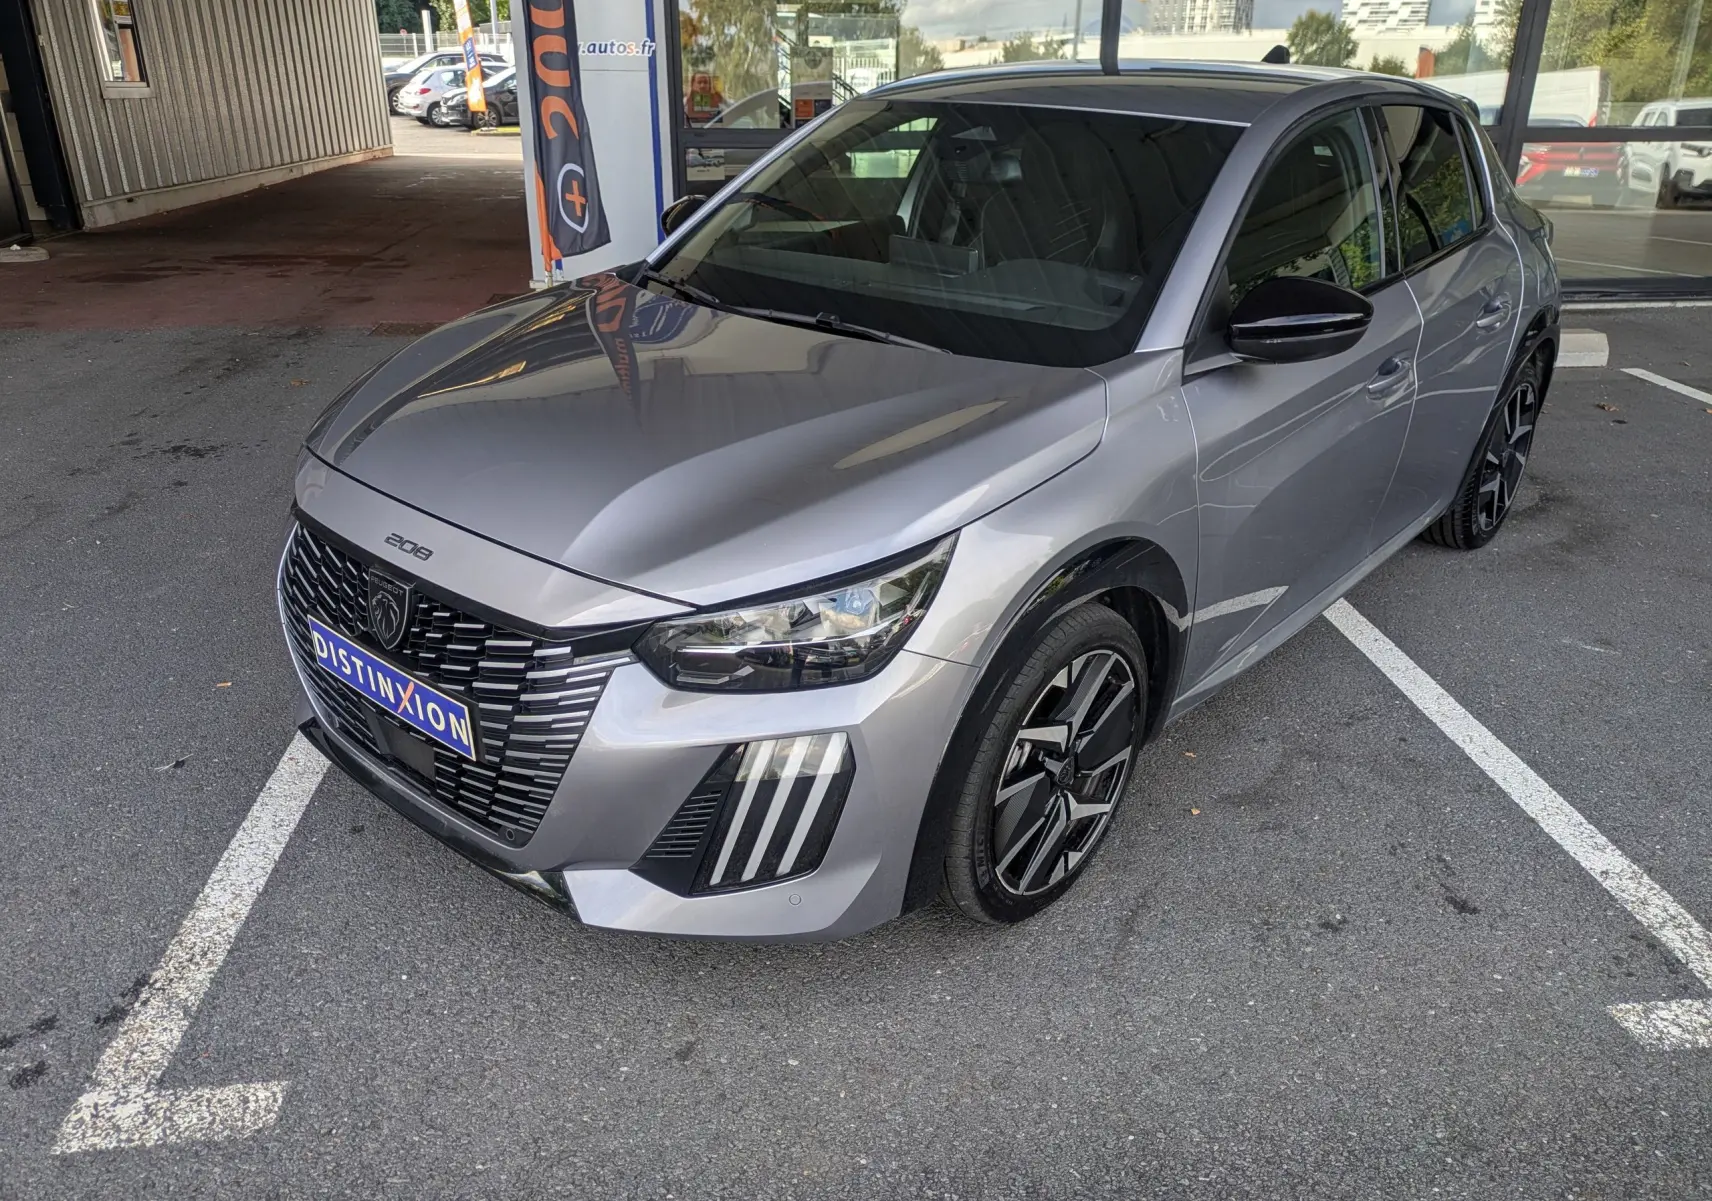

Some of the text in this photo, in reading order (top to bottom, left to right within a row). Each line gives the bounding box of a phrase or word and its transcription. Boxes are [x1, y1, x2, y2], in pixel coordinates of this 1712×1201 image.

[383, 532, 434, 562] 208
[370, 575, 404, 597] PEUGEOT
[312, 630, 469, 747] DISTINXION
